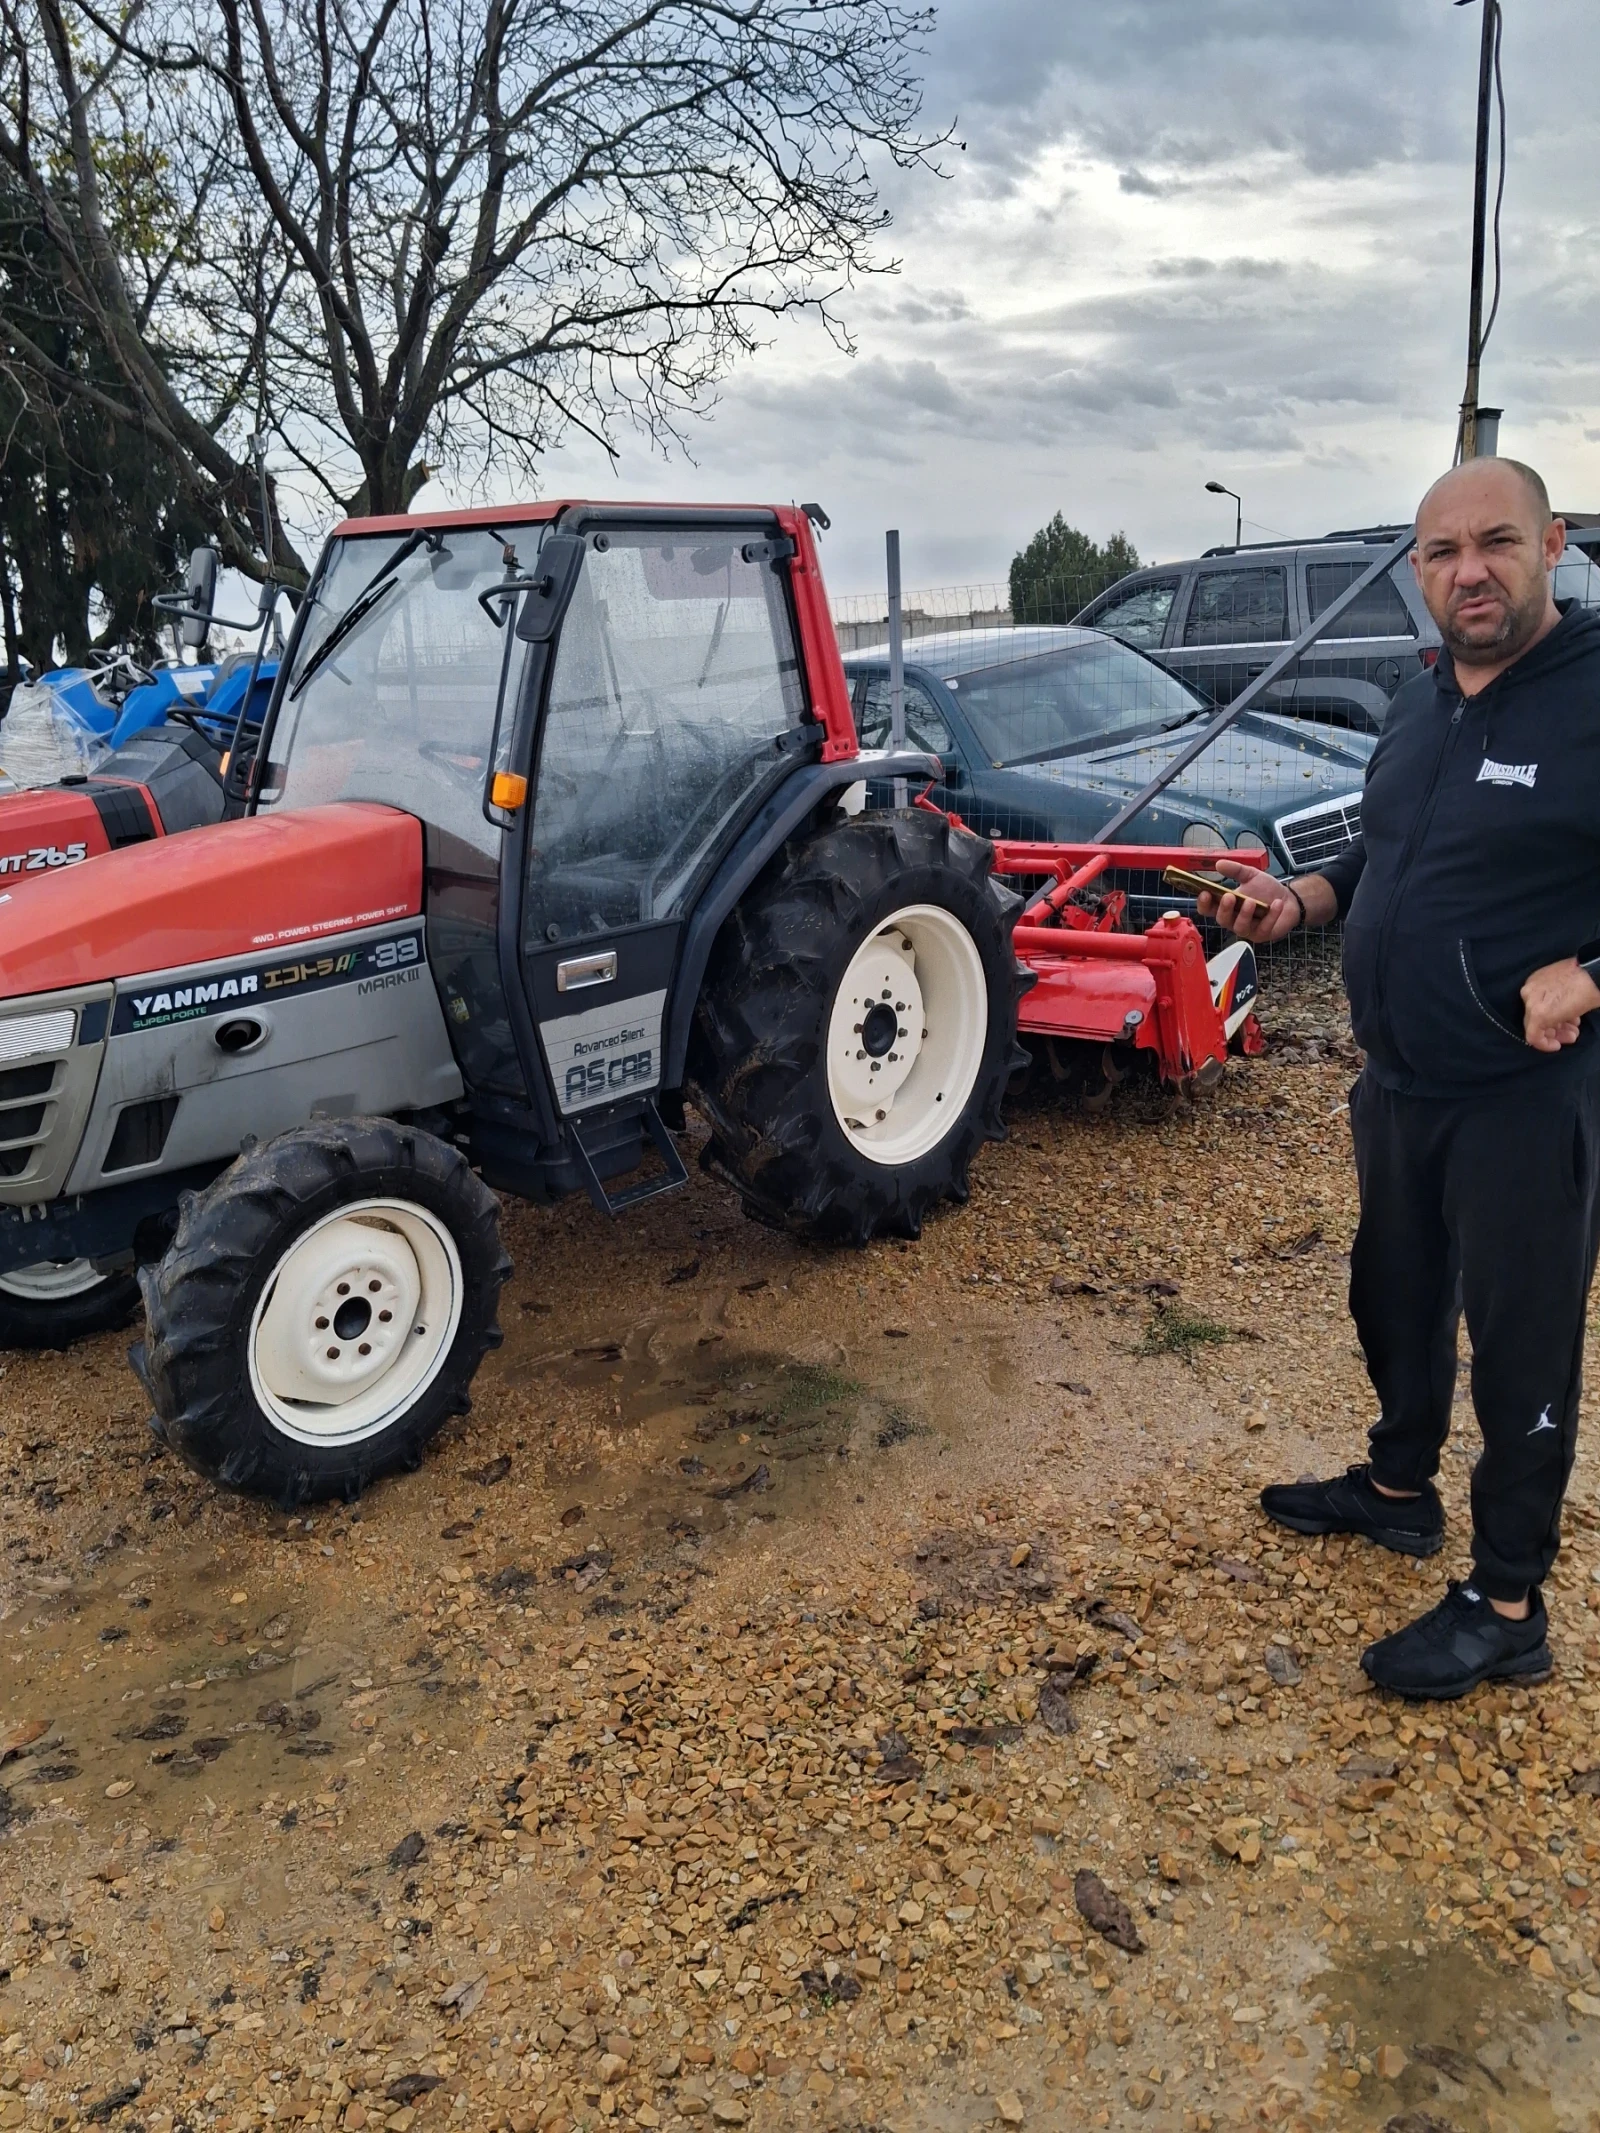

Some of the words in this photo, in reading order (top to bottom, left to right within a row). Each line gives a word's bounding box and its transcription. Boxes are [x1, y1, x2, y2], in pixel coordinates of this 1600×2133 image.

[1476, 758, 1538, 788] LONSDALE
[278, 926, 310, 939] POWER
[386, 904, 408, 916] SHIFT
[132, 975, 258, 1016] YANMAR
[133, 1014, 171, 1029] SUPER
[172, 1006, 207, 1021] FORTE
[574, 1035, 620, 1056] Advanced
[620, 1027, 645, 1043] Silent
